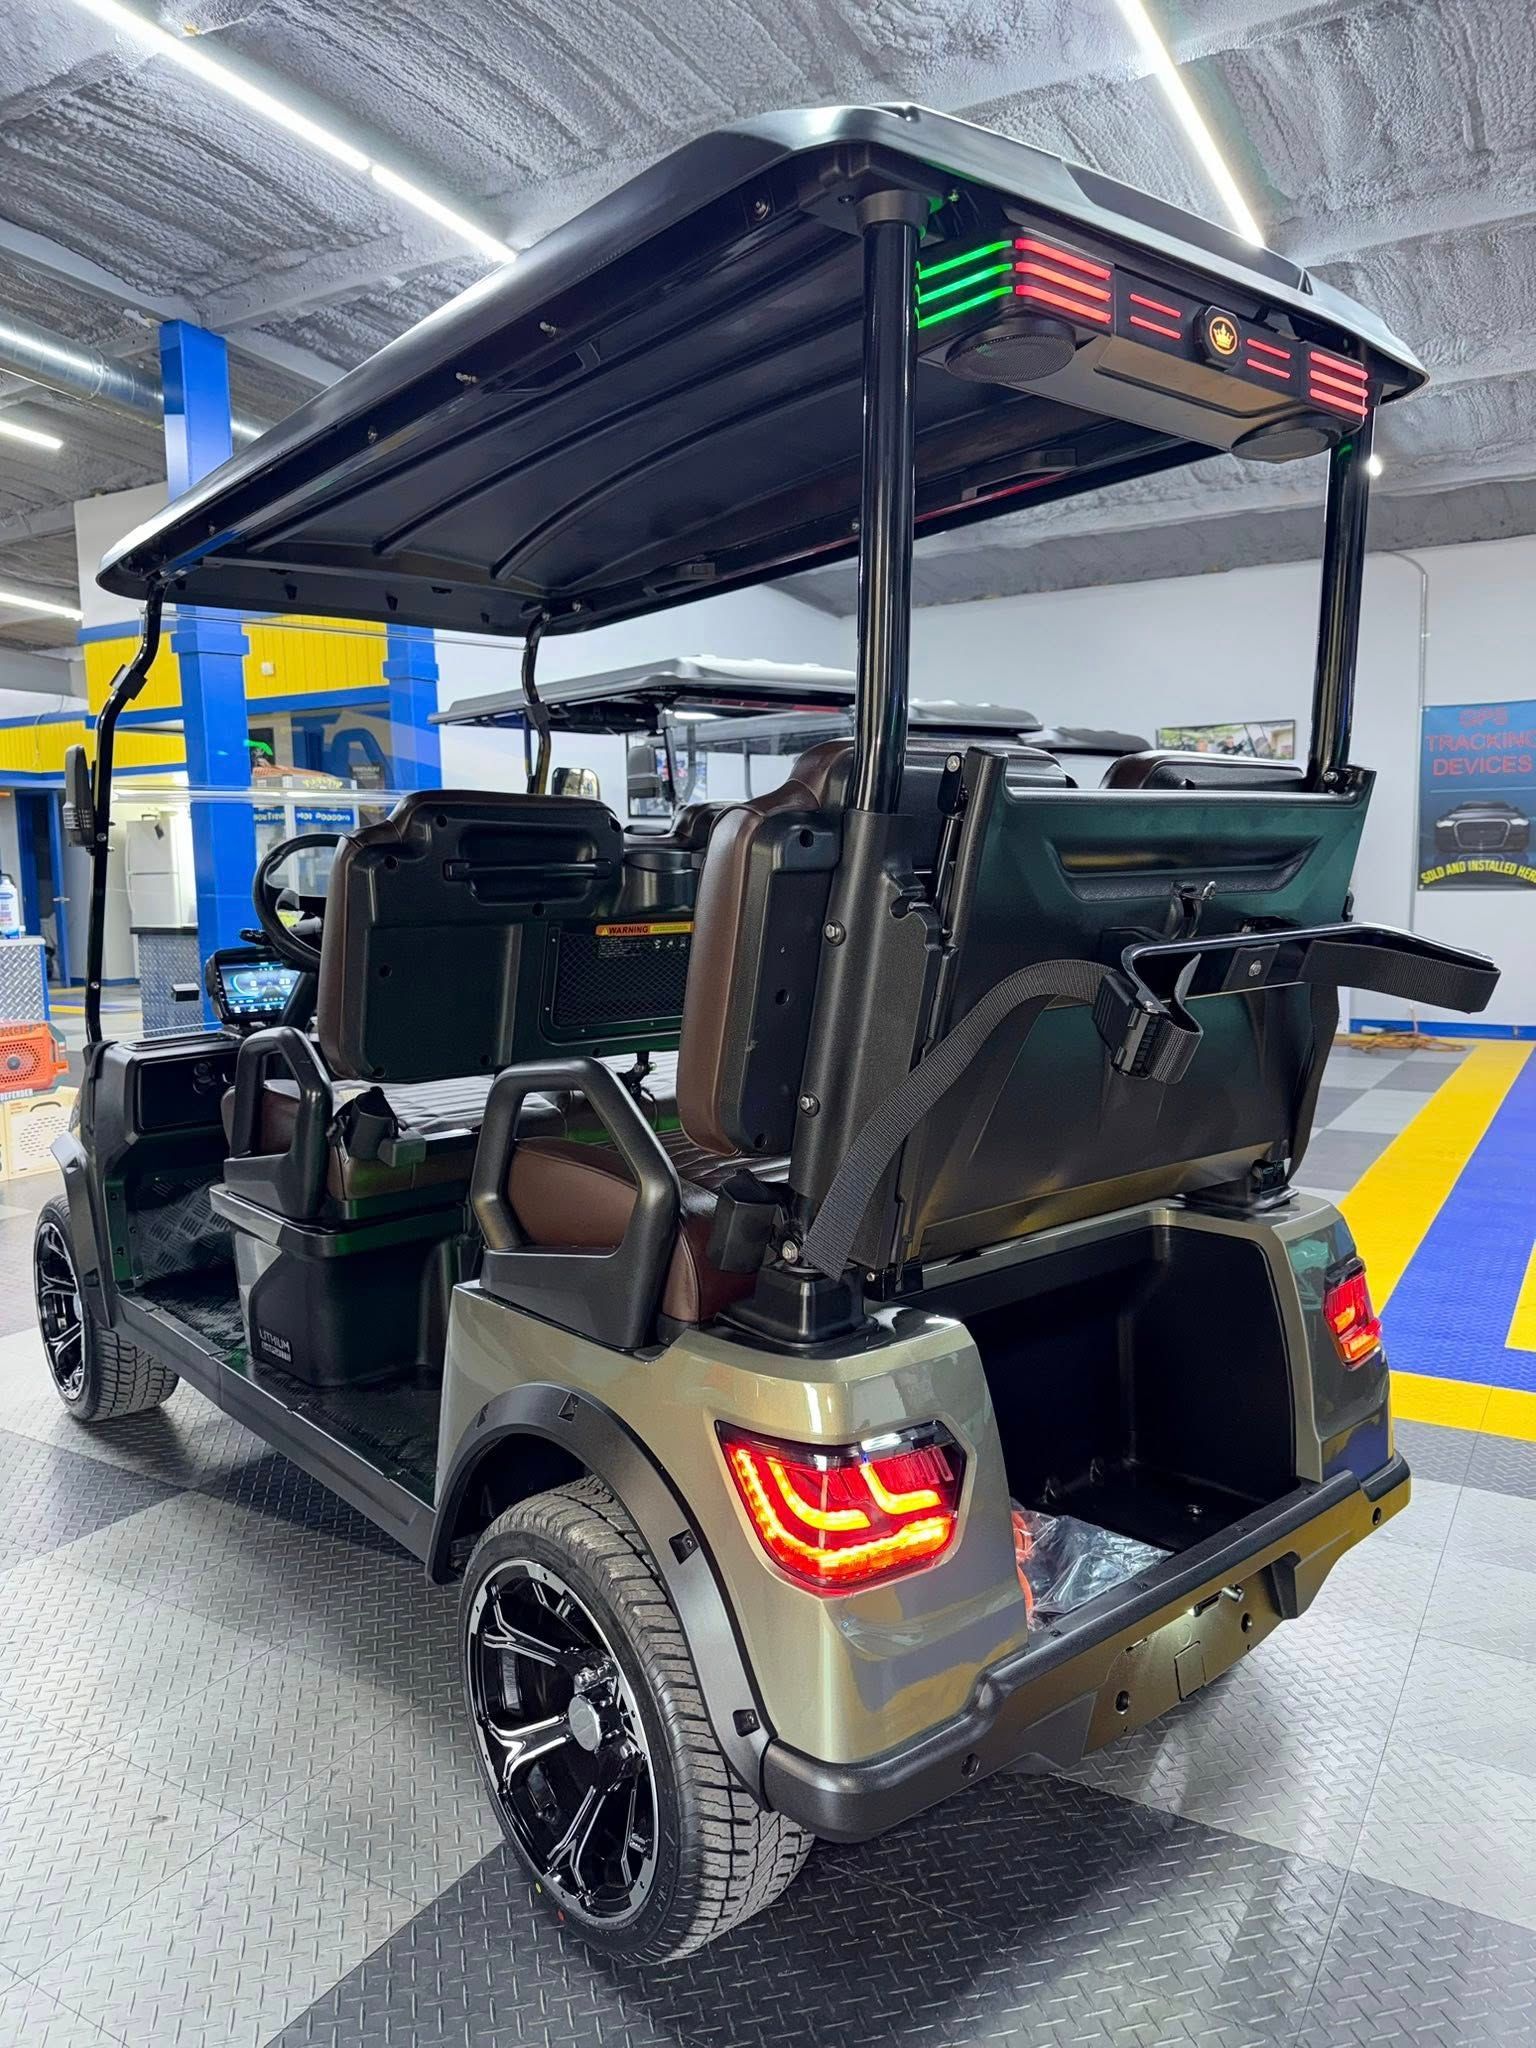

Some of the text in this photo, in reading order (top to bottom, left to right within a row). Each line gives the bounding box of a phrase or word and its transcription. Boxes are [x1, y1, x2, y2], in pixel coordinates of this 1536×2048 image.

[1432, 755, 1532, 776] DEVICES
[1421, 866, 1445, 884] SOLD
[1446, 861, 1466, 875] AND
[1468, 860, 1517, 875] INSTALLED
[609, 926, 649, 934] WARNING
